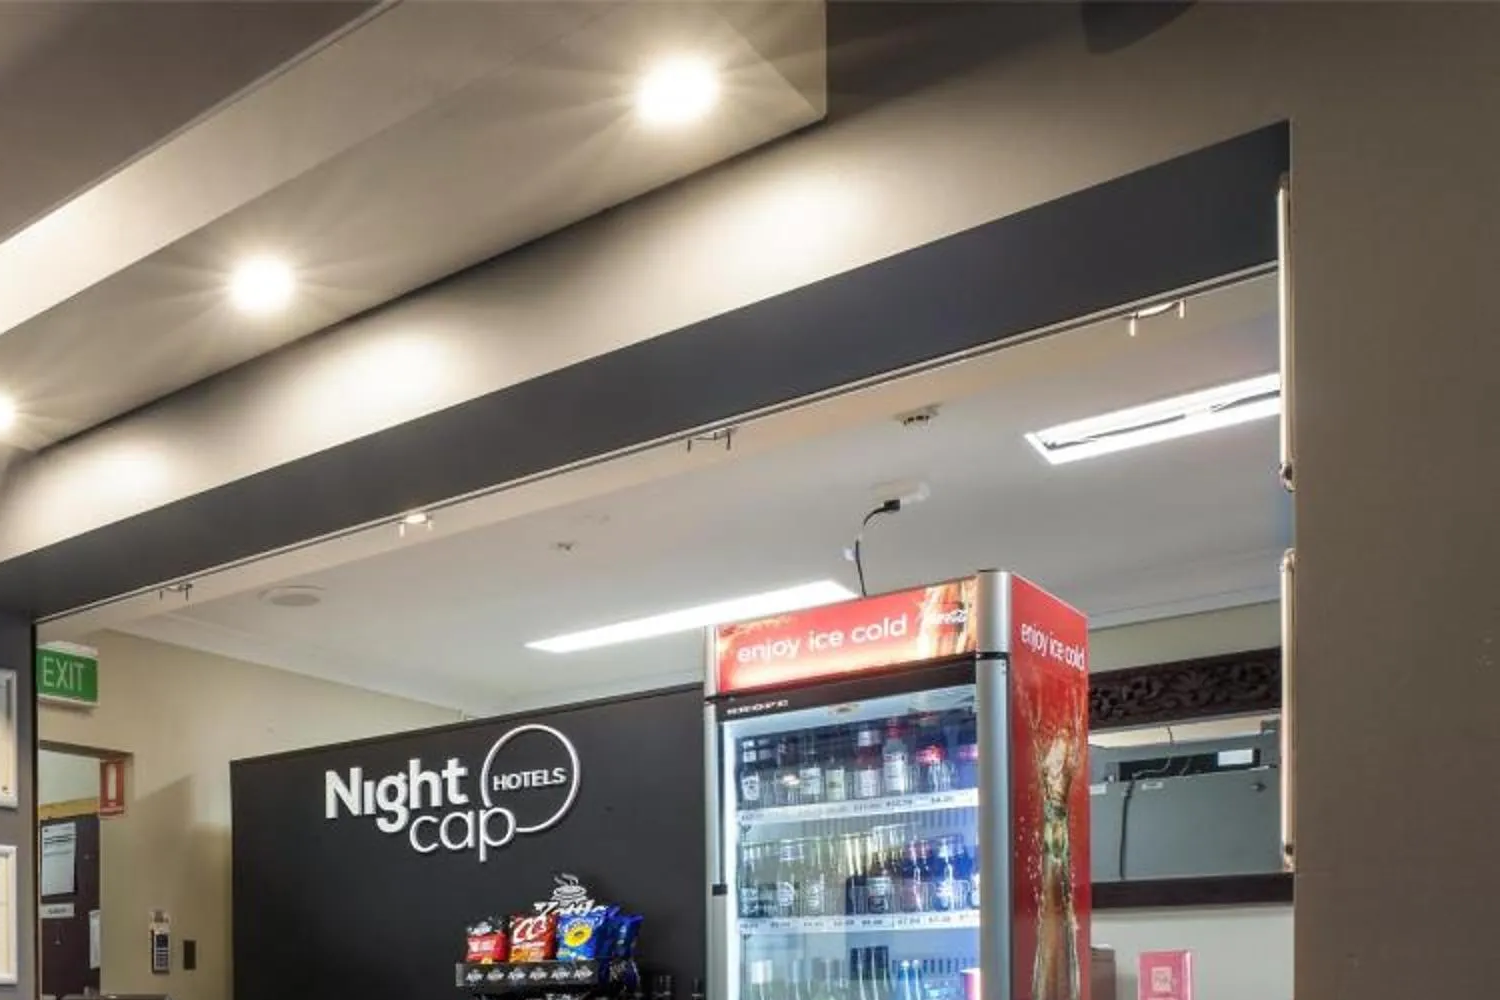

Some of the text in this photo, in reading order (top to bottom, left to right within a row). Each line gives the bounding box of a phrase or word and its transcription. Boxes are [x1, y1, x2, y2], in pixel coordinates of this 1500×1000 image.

[736, 637, 801, 665] enjoy
[808, 628, 844, 652] ice
[850, 614, 908, 643] cold
[1019, 622, 1086, 671] enjoy ice cold
[41, 655, 85, 692] EXIT
[325, 757, 469, 833] Night
[493, 766, 567, 791] HOTELS
[409, 806, 516, 863] cap
